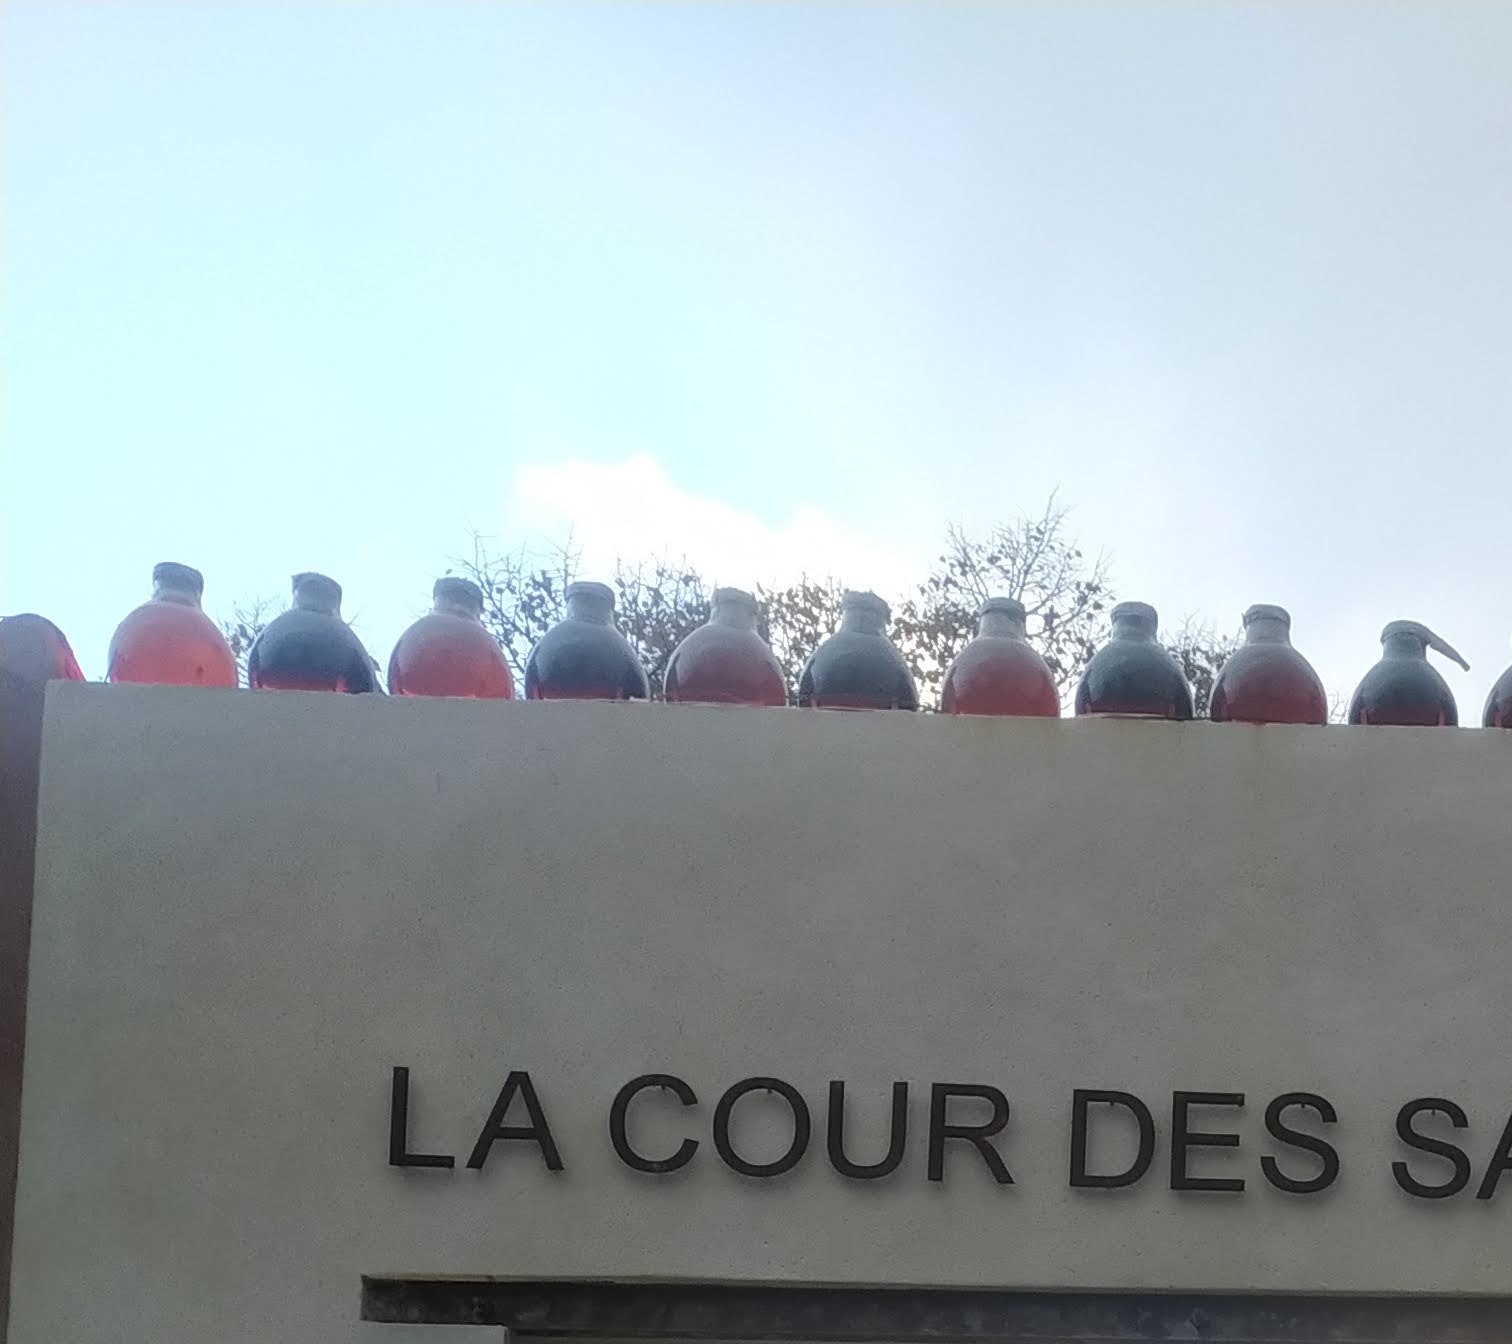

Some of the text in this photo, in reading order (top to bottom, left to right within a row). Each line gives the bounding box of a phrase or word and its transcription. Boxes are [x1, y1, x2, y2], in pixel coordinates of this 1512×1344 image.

[388, 1066, 564, 1171] LA
[608, 1073, 1016, 1185] COUR
[1069, 1088, 1341, 1194] DES
